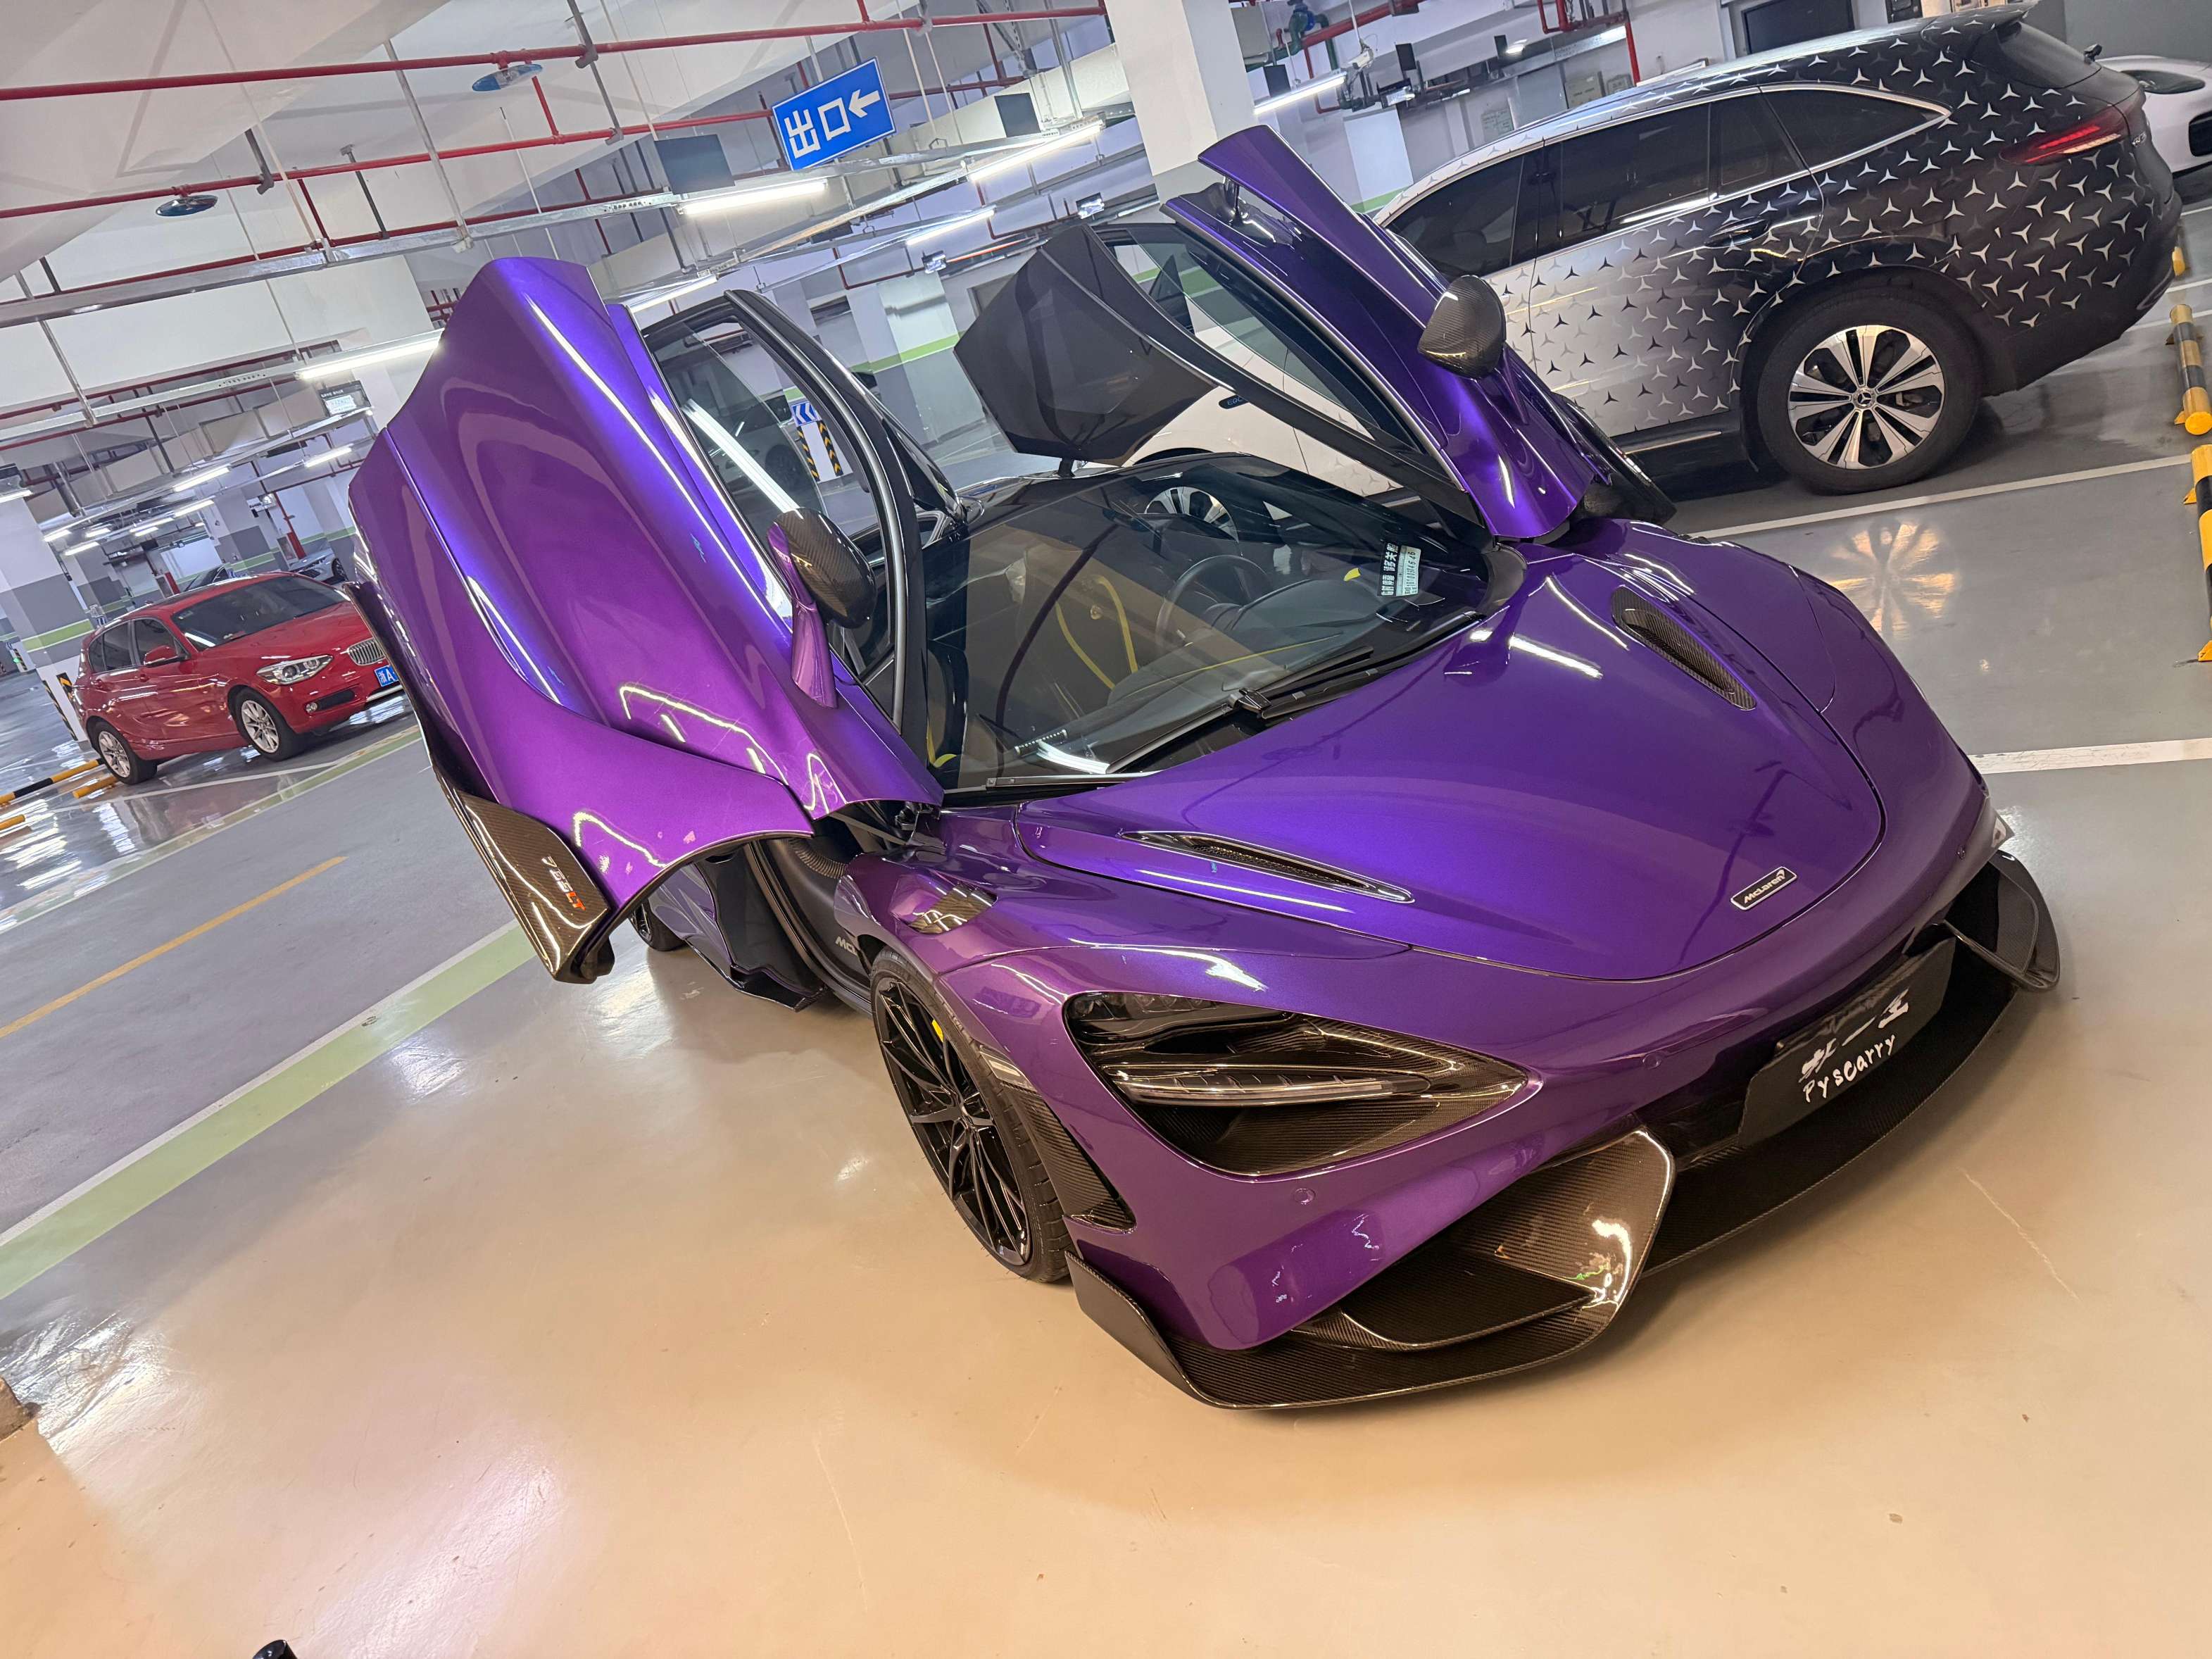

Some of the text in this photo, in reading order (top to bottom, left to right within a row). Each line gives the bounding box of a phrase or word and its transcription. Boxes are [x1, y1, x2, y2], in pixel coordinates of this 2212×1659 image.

[784, 97, 851, 159] 出口
[541, 856, 586, 911] 765LT
[1744, 875, 1786, 904] McLaren
